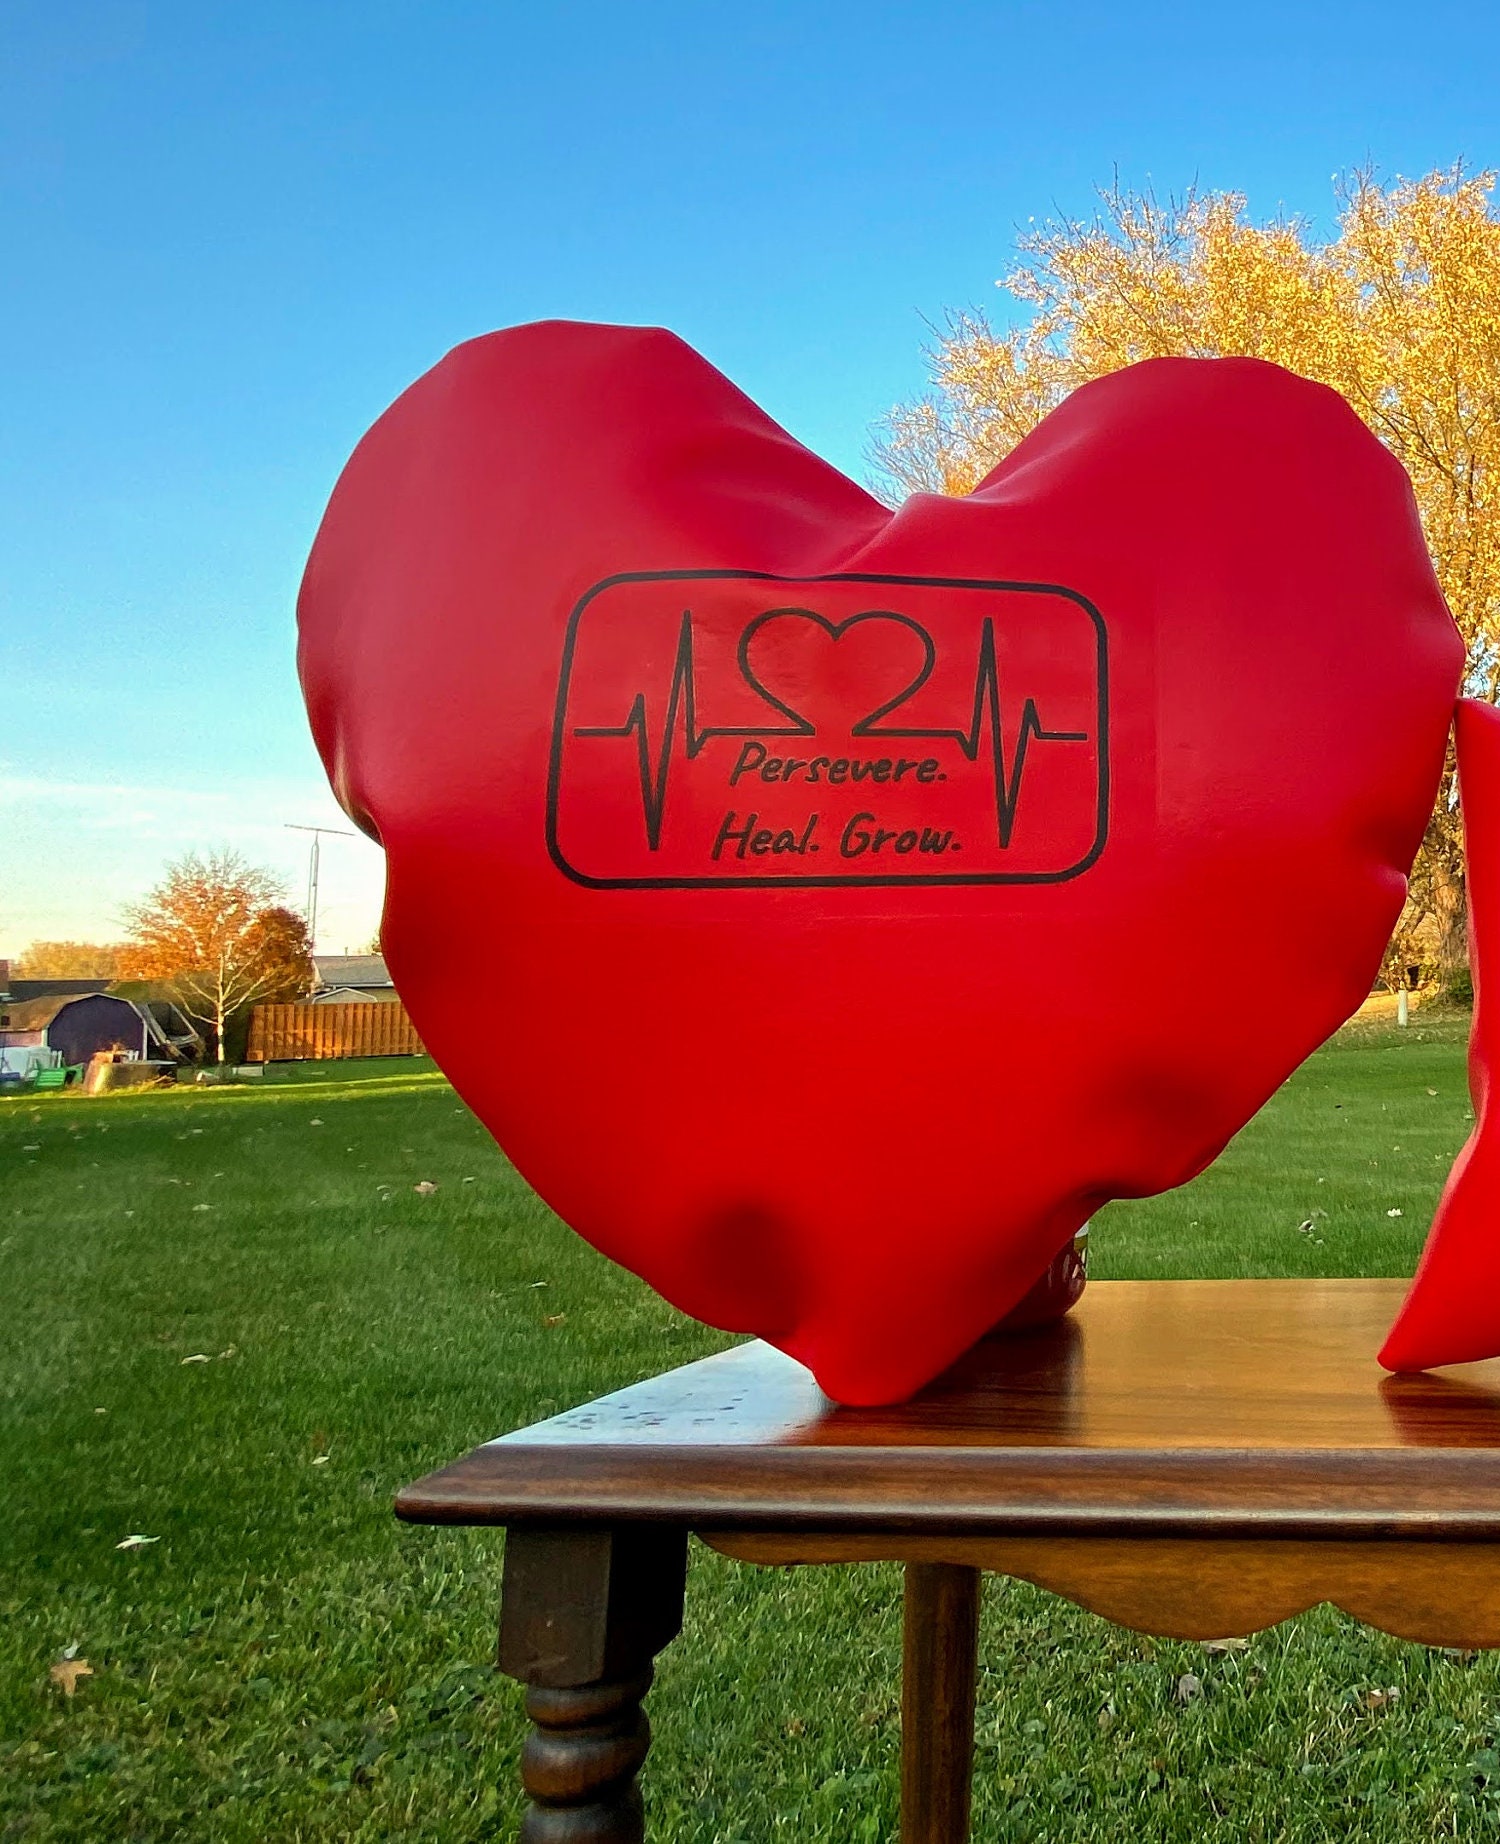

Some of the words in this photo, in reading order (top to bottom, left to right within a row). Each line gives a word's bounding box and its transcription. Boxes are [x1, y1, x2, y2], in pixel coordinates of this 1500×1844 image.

[730, 741, 947, 785] Persevere.
[712, 811, 819, 861] Heal.
[839, 812, 962, 859] Grow.
